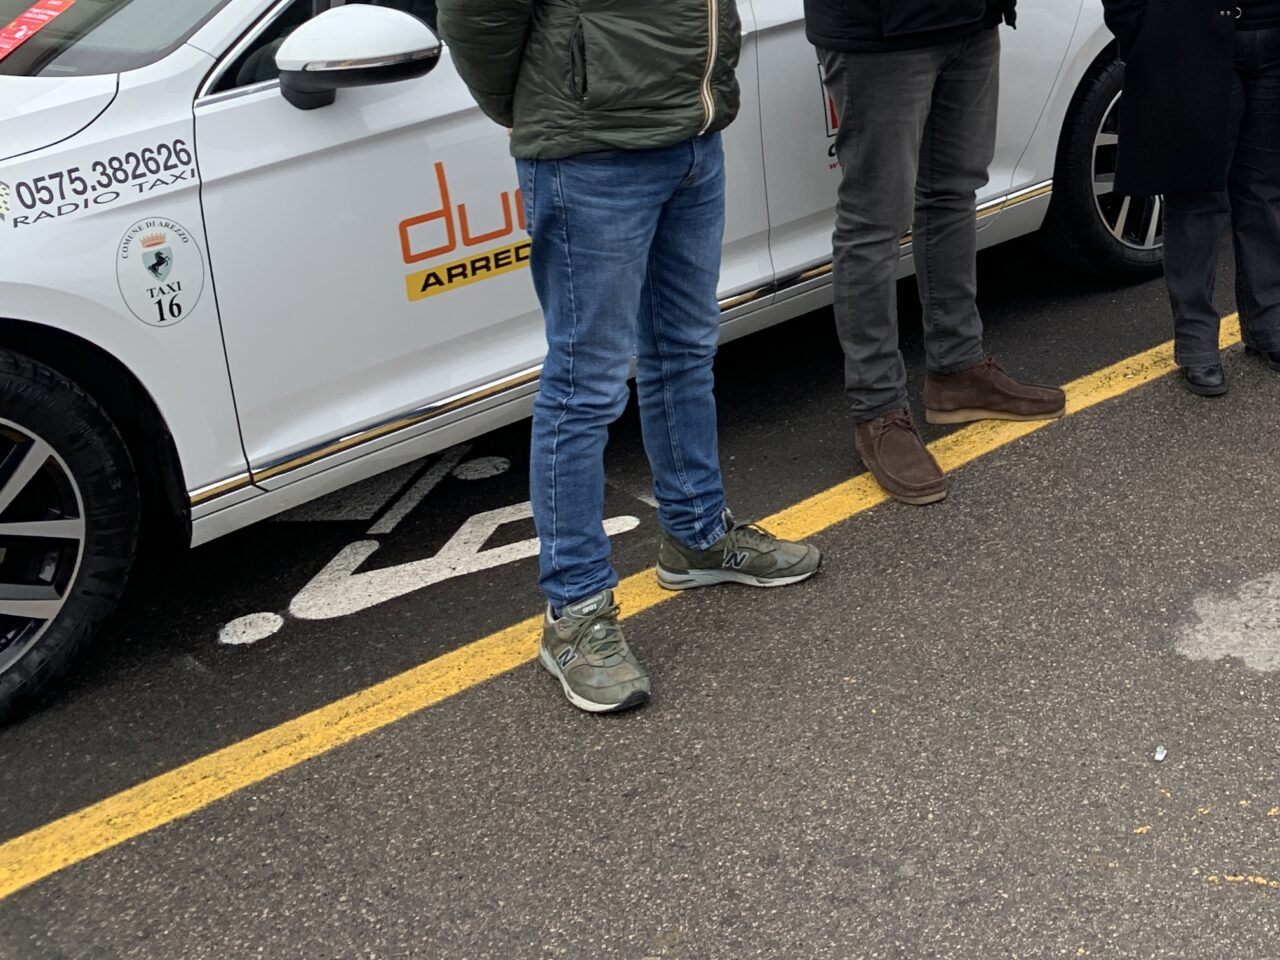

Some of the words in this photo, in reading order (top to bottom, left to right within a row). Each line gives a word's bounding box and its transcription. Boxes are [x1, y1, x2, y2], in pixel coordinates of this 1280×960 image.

[16, 139, 192, 210] 0575.382626
[13, 191, 120, 228] RADIO
[132, 168, 196, 193] TAXI
[121, 225, 145, 259] COMUNE
[145, 221, 156, 229] DI
[158, 221, 189, 244] AREZZO
[420, 243, 532, 292] ARRED
[147, 281, 182, 298] TAXI
[154, 294, 182, 322] 16
